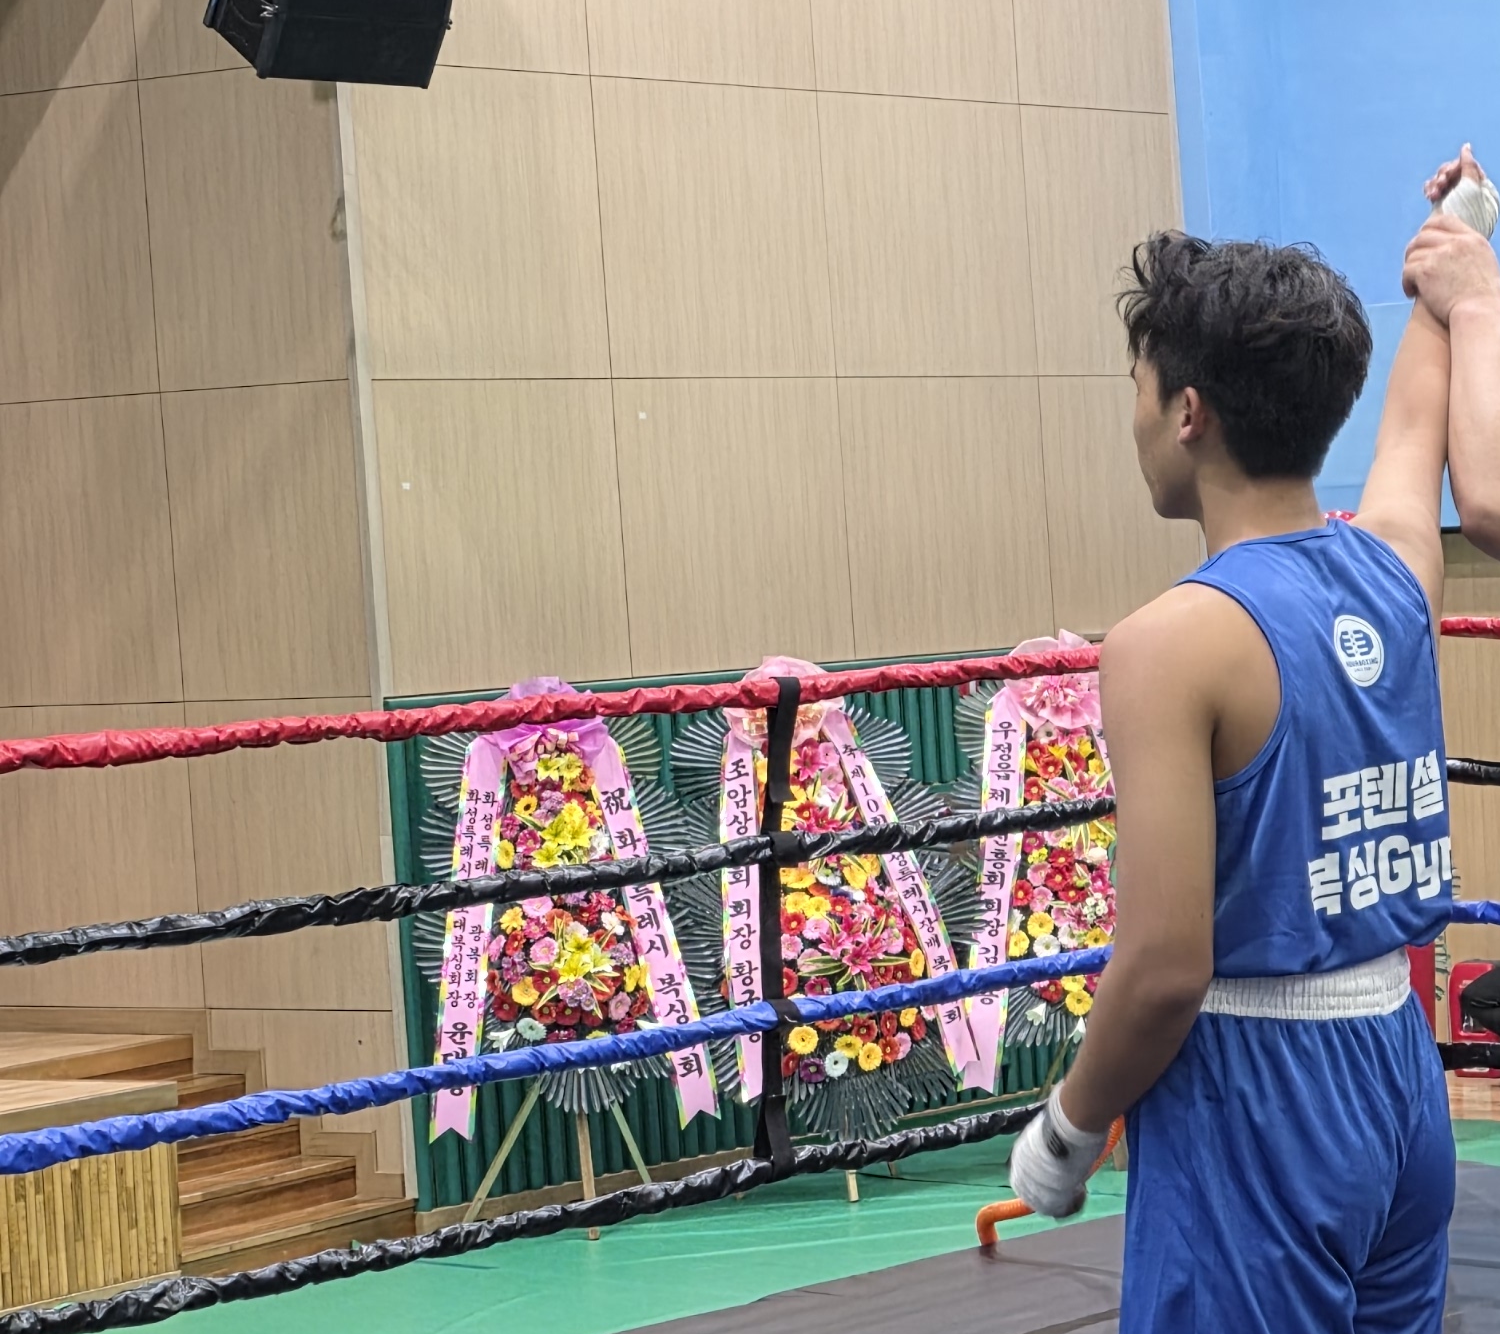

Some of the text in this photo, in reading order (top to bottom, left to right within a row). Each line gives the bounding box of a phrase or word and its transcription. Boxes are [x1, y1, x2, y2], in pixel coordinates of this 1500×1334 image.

[475, 791, 497, 874] 화성특례
[602, 787, 631, 815] 祝
[726, 758, 753, 889] 조암상회
[1321, 749, 1444, 841] 포텐셜
[889, 852, 941, 949] 성특례시장배
[615, 828, 704, 1079] 화특례시 복싱회
